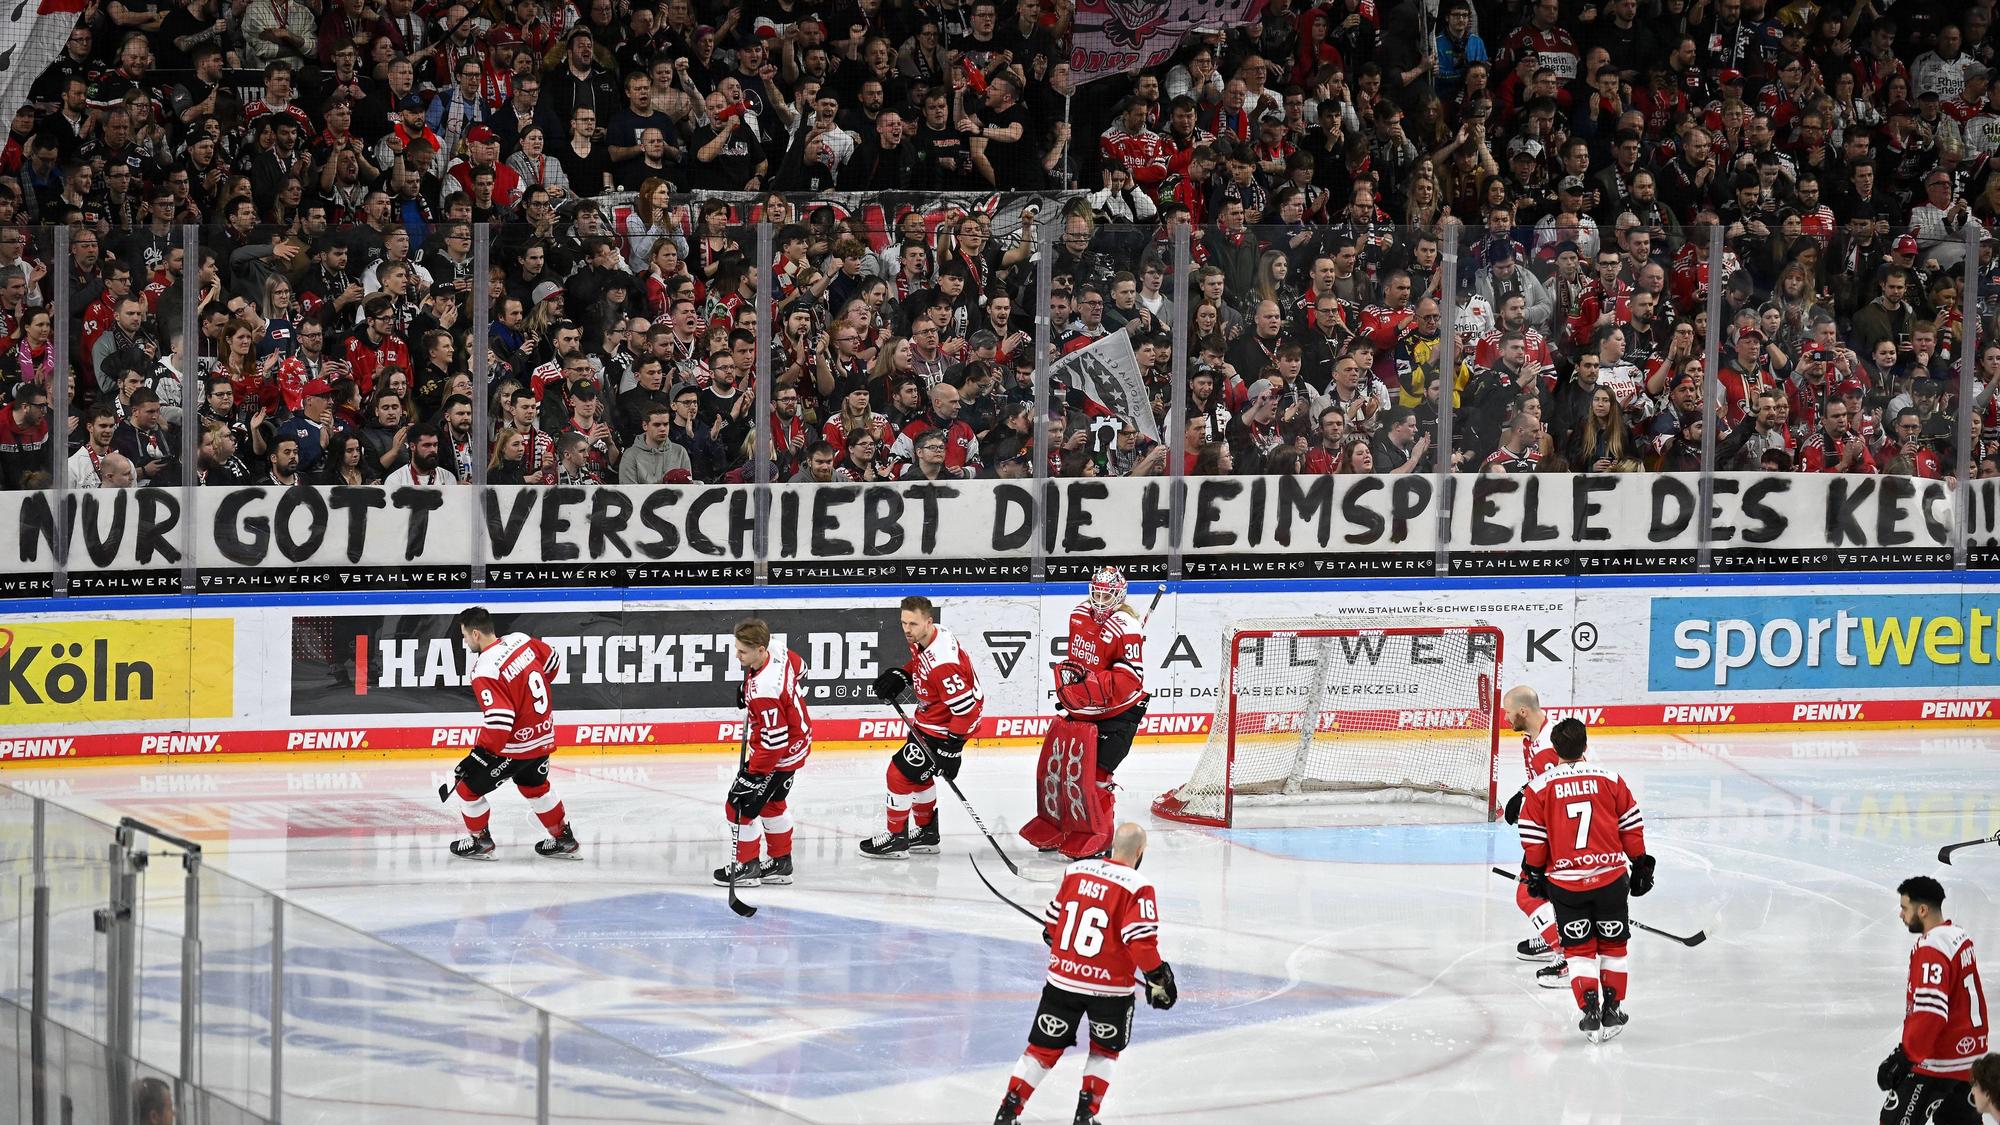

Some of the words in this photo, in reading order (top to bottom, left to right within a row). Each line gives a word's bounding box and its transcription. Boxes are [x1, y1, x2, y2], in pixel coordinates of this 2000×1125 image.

[1540, 64, 1573, 74] nergie
[1936, 86, 1966, 96] Energ
[19, 487, 182, 567] NUR
[213, 486, 444, 566] GOTT
[481, 483, 961, 561] VERSCHIEBT
[991, 481, 1110, 554] DIE
[1141, 474, 1620, 550] HEIMSPIELE
[1647, 476, 1792, 543] DES
[1338, 603, 1564, 615] WWW.STAHLWERK-SCHWEISSGERAETE.DE
[1074, 633, 1097, 655] Rhein
[1124, 643, 1140, 660] 30
[2, 639, 154, 704] Köln
[528, 670, 549, 715] 9
[942, 673, 965, 695] 55
[1327, 683, 1419, 695] WERKZEUG
[480, 689, 494, 707] 9
[760, 707, 780, 729] 17
[1554, 779, 1599, 799] BAILEN
[1566, 801, 1593, 850] 7
[1574, 850, 1626, 865] TOYOTA
[1077, 879, 1109, 901] BAST
[1138, 898, 1156, 920] 16
[1059, 900, 1109, 958] 16
[1060, 959, 1111, 981] TOYOTA
[1922, 962, 1943, 985] 13
